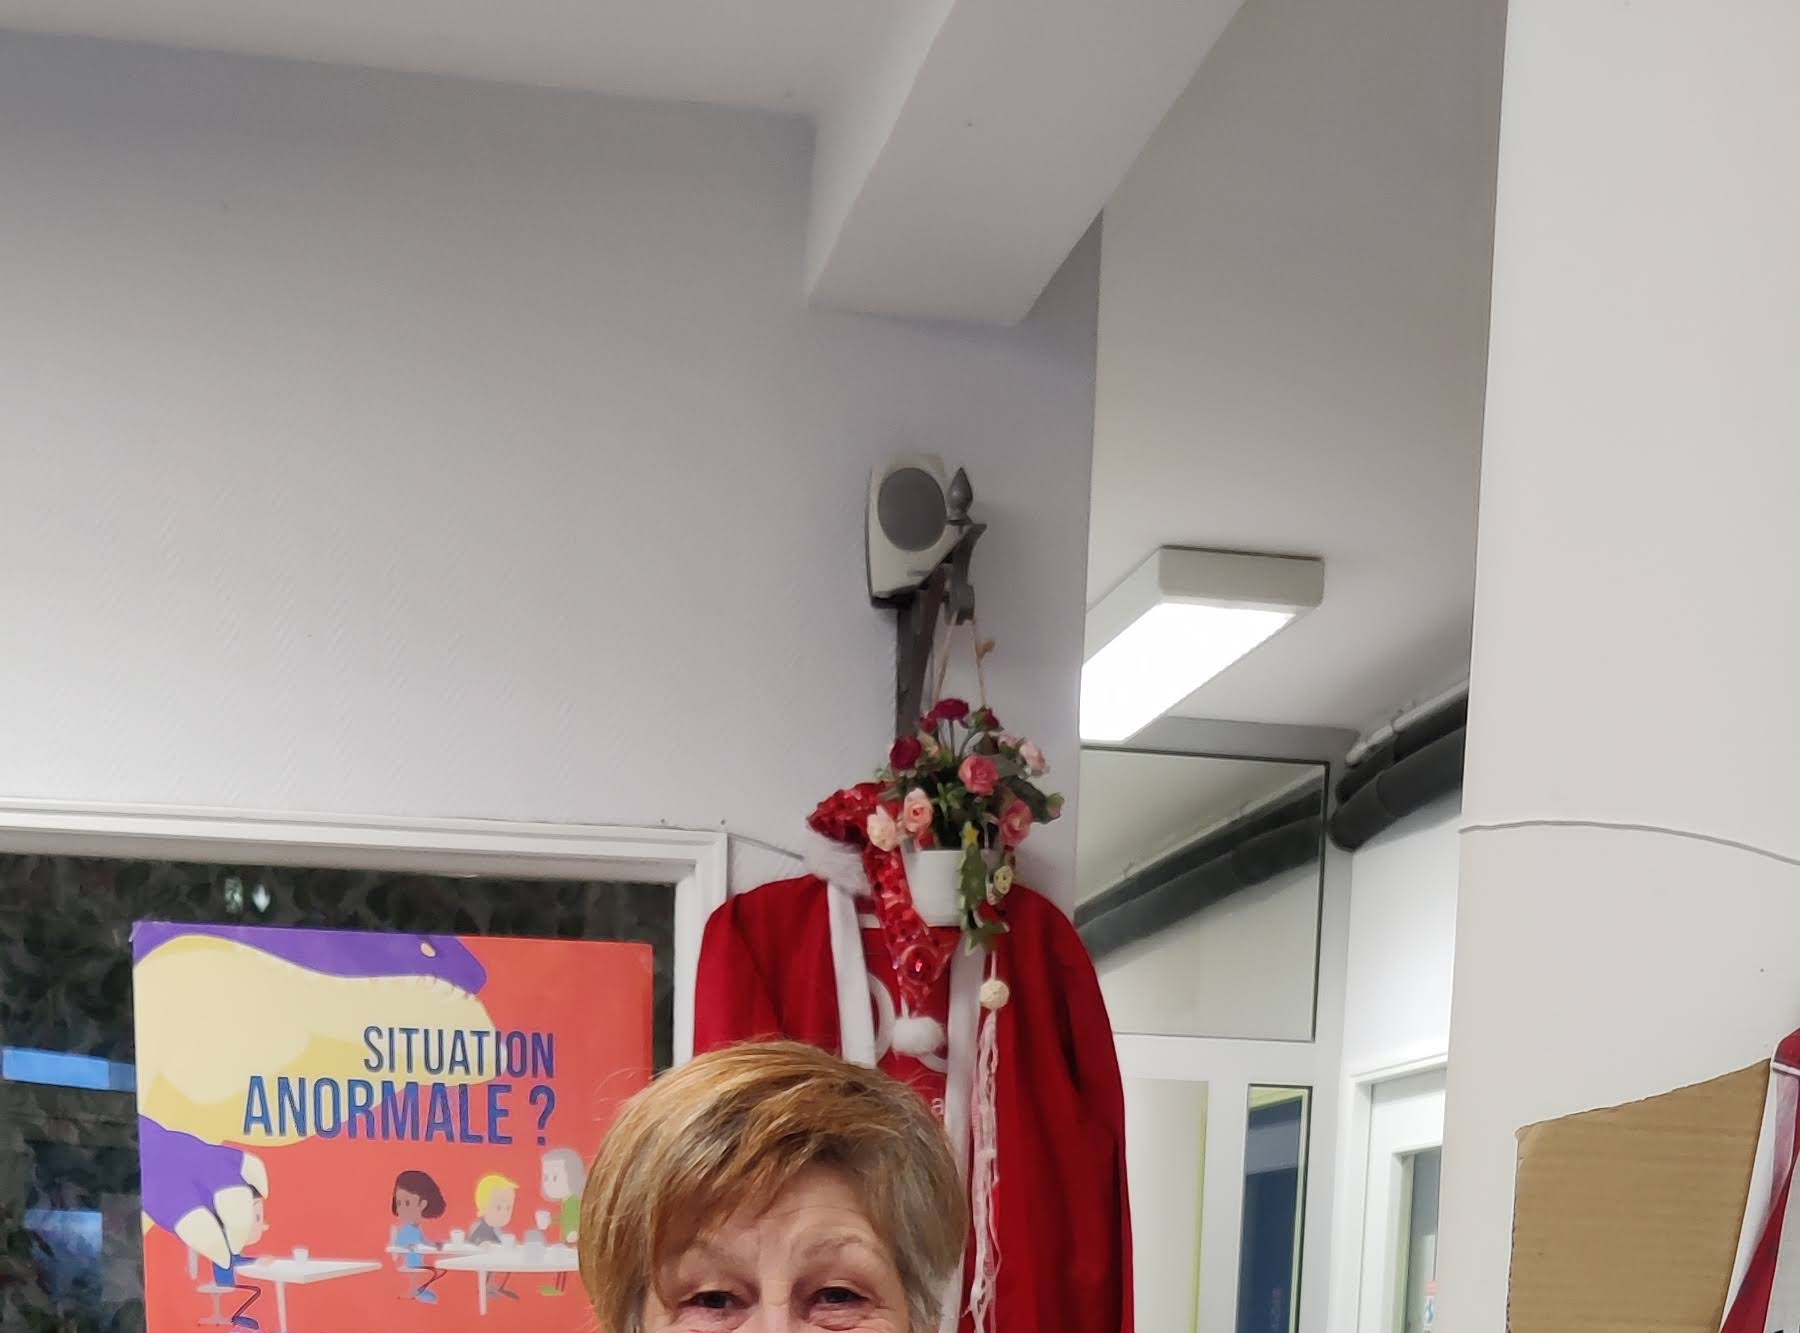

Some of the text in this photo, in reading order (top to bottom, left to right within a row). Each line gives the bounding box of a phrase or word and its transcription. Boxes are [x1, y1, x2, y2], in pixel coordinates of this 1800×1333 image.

[363, 1025, 555, 1079] SITUATION
[243, 1075, 556, 1146] ANORMALE ?
